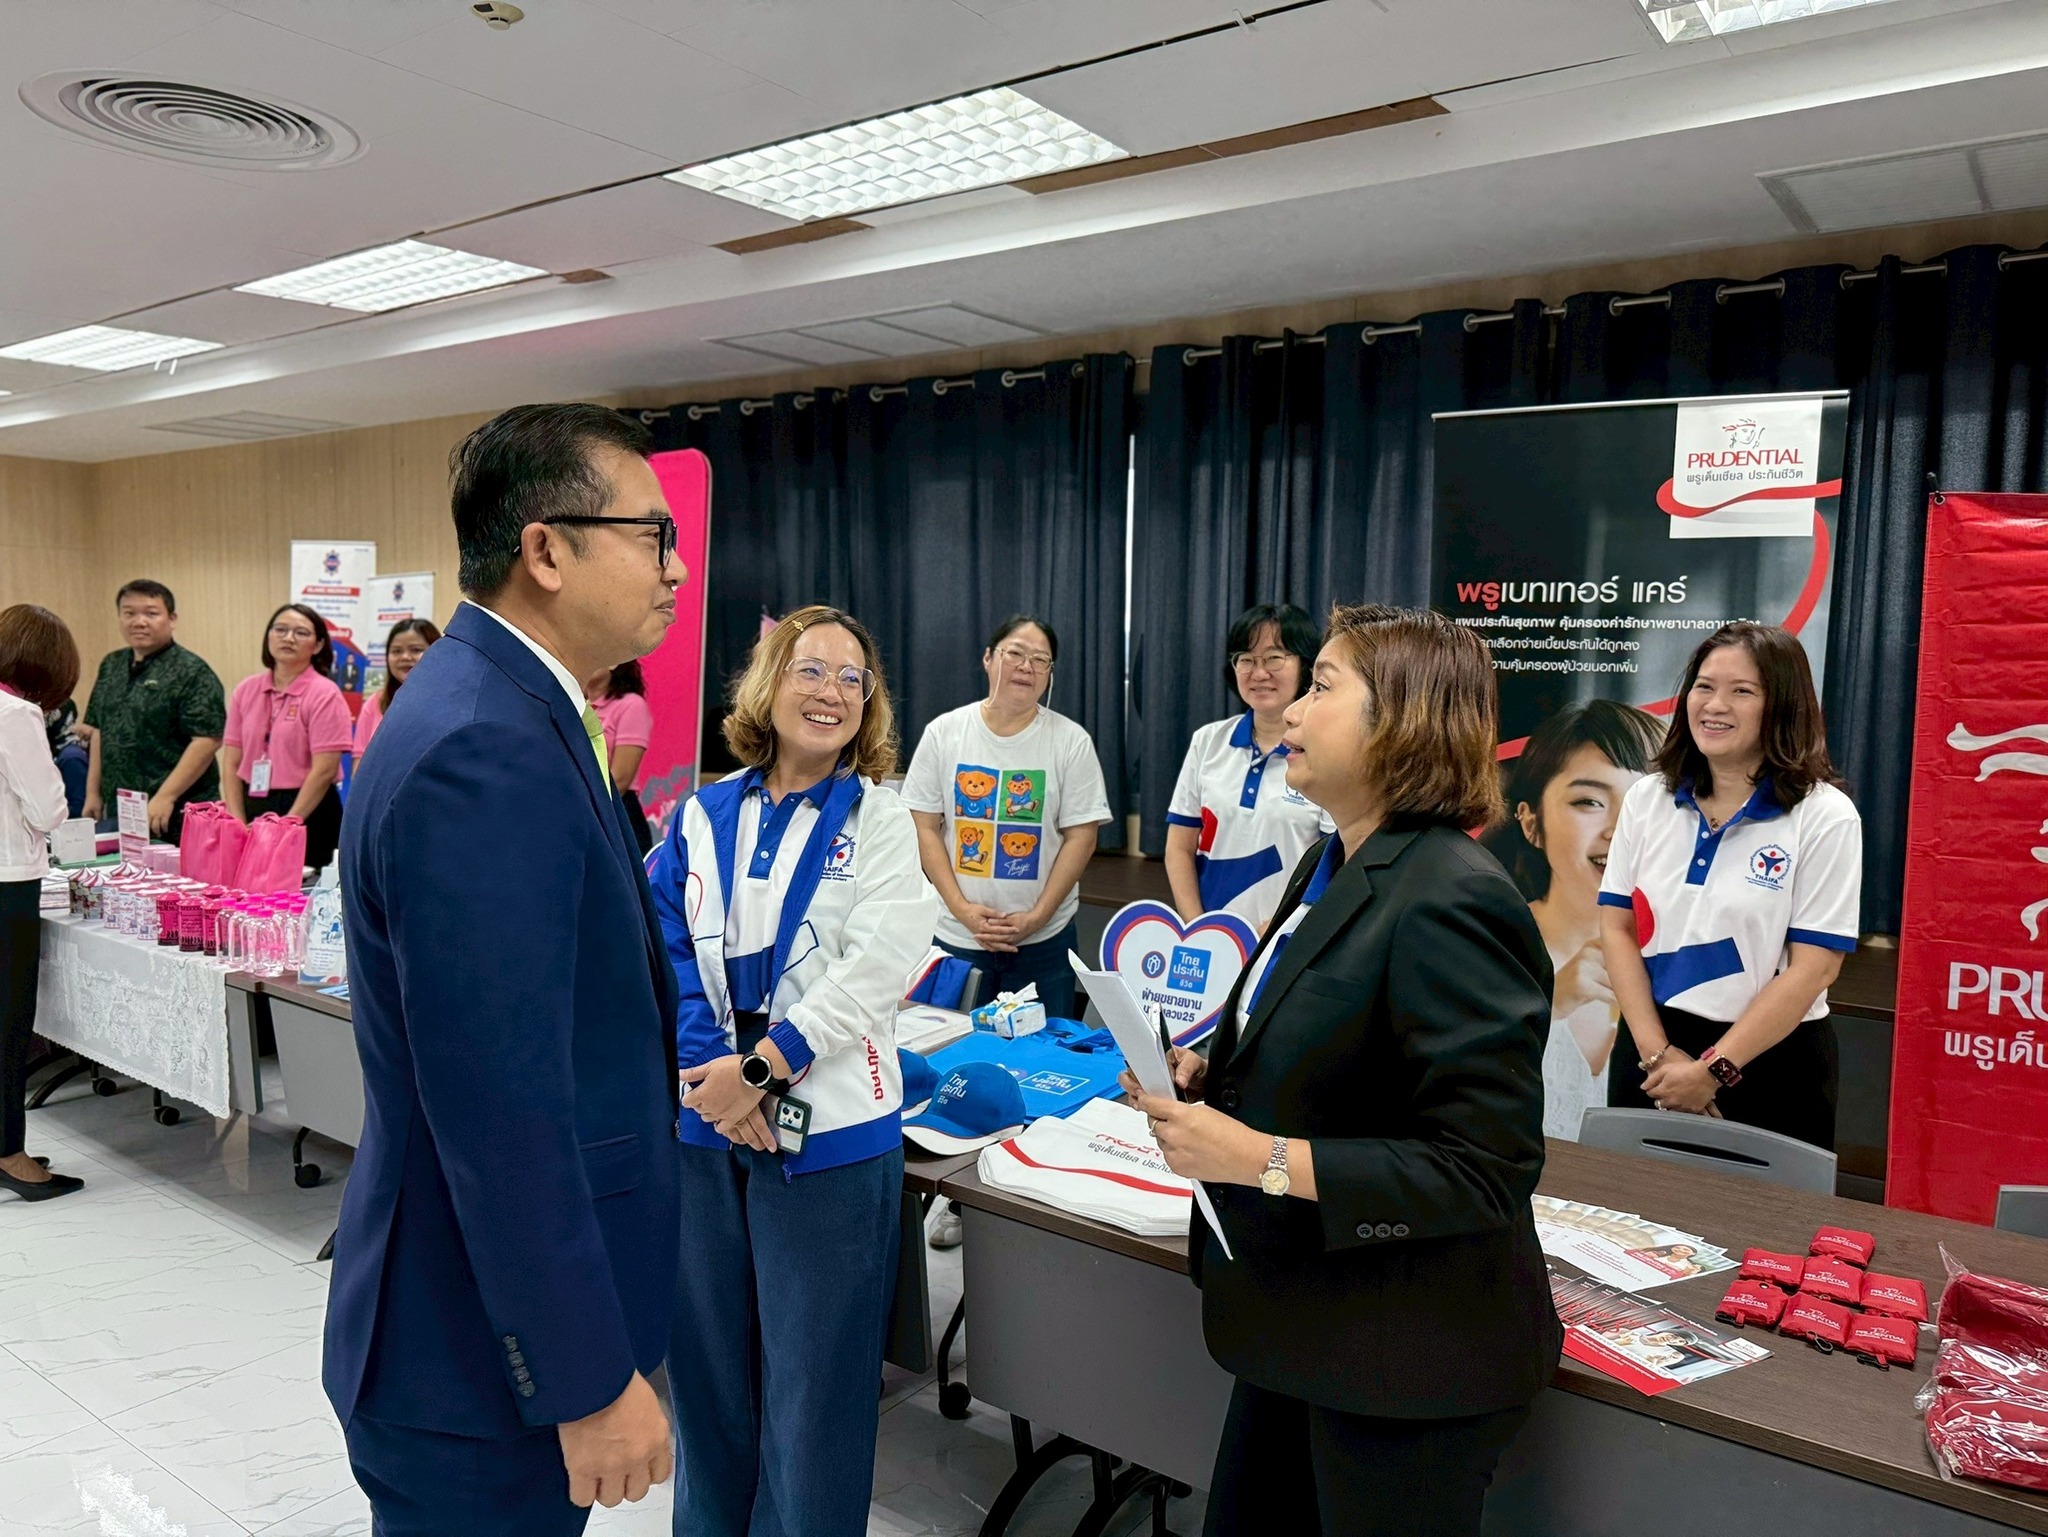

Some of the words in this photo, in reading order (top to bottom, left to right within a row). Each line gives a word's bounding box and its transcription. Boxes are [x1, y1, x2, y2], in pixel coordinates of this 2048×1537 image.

[1687, 448, 1804, 468] PRUDENTIAL
[1686, 471, 1743, 485] พรูเด็นเชียล
[1748, 468, 1803, 480] ประกันชีวิต
[1456, 575, 1620, 611] พรูเบทเทอร์
[1632, 575, 1688, 604] แคร์
[1455, 615, 1556, 630] แผนประกันสุขภาพ
[1491, 658, 1638, 674] วามคุ้มครองผู้ป่วยนอกเพิ่ม
[1179, 951, 1200, 966] ไทย
[1173, 963, 1205, 979] ประกัน
[1142, 987, 1203, 1011] ฝ่ายขยายงาน
[1087, 1140, 1140, 1164] พรูเด็นเชียล
